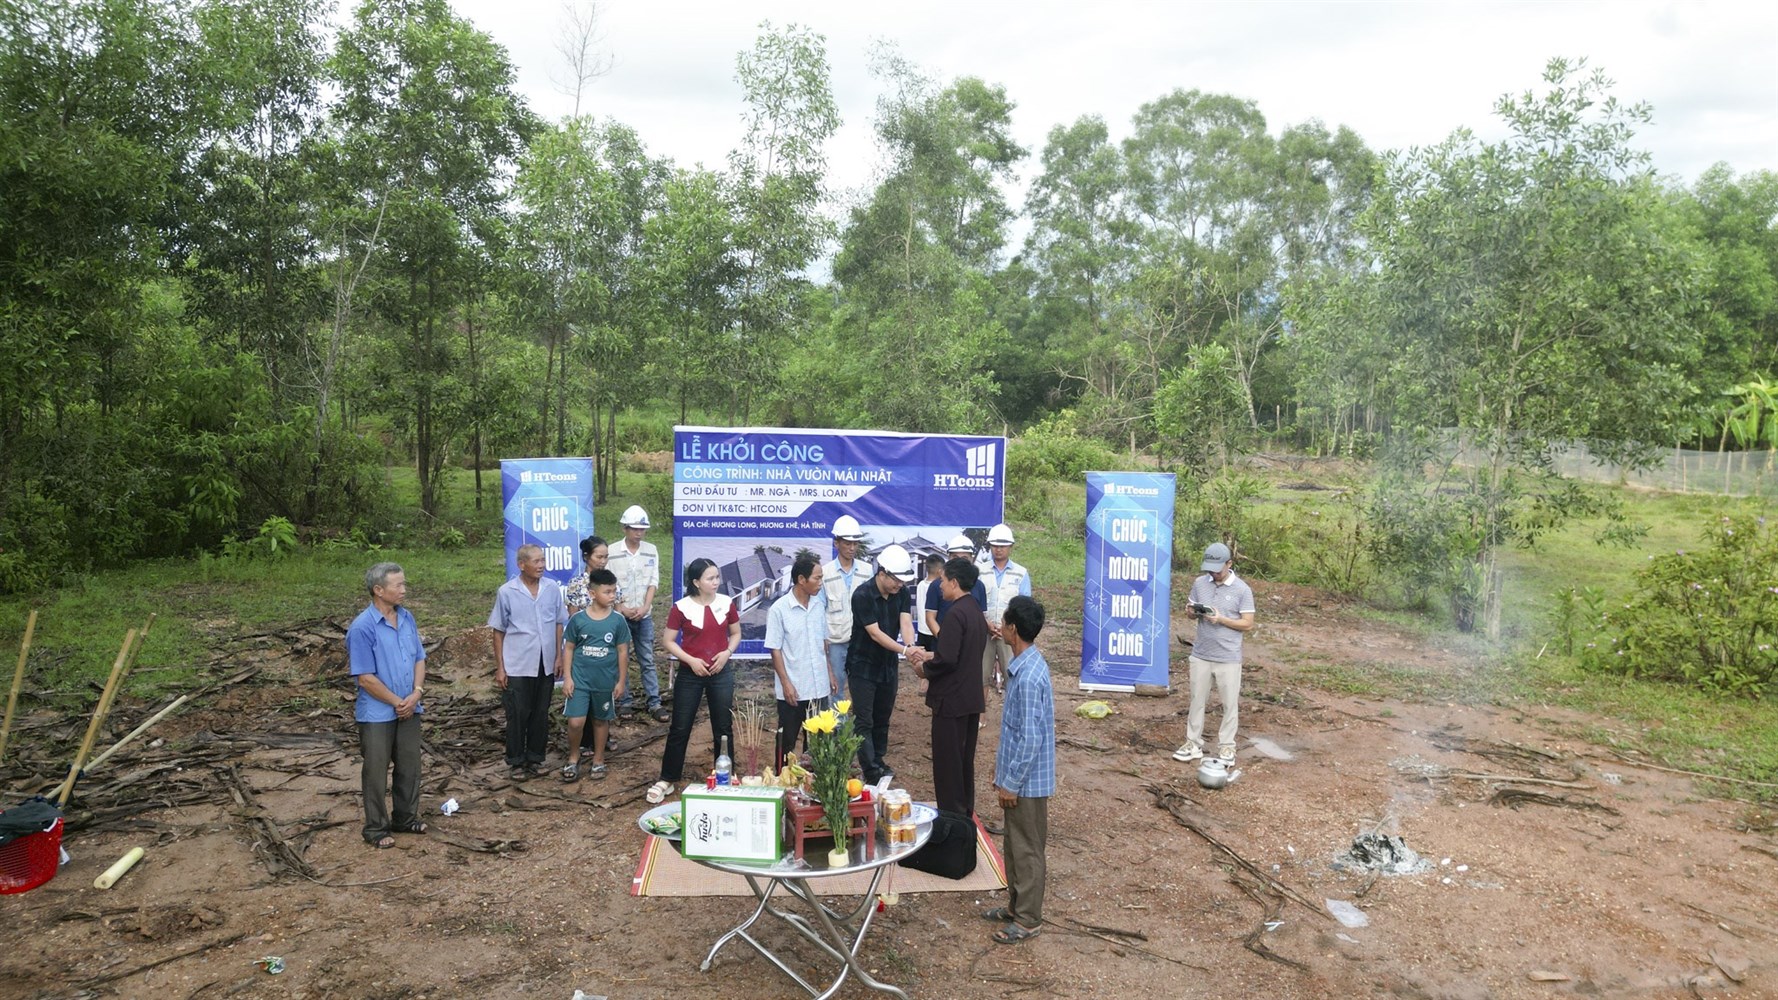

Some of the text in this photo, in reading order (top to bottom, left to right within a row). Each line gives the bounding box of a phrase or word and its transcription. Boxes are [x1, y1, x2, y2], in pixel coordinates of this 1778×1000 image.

[682, 435, 824, 462] LỄ KHỞI CÔNG
[534, 472, 577, 482] HTcons
[682, 465, 892, 484] CÔNG TRÌNH: NHÀ VƯỜN MÁI NHẬT
[933, 474, 995, 487] HTcons
[727, 487, 738, 495] TƯ
[750, 487, 766, 496] MR.
[799, 488, 819, 497] MRS.
[822, 488, 848, 497] LOAN
[1116, 485, 1159, 495] HTcons
[532, 503, 569, 532] CHÚC
[682, 503, 788, 514] ĐƠN VỊ TK&TC: HTCONS
[683, 520, 695, 530] ĐỊA
[711, 521, 736, 529] HƯƠNG
[737, 521, 759, 530] LONG,
[760, 521, 784, 529] HƯƠNG
[801, 520, 810, 529] HÀ
[1112, 514, 1148, 543] CHÚC
[541, 543, 573, 571] ỪNG
[1108, 553, 1148, 581] MỪNG
[1111, 590, 1143, 619] KHỞI
[1108, 629, 1143, 657] CÔNG
